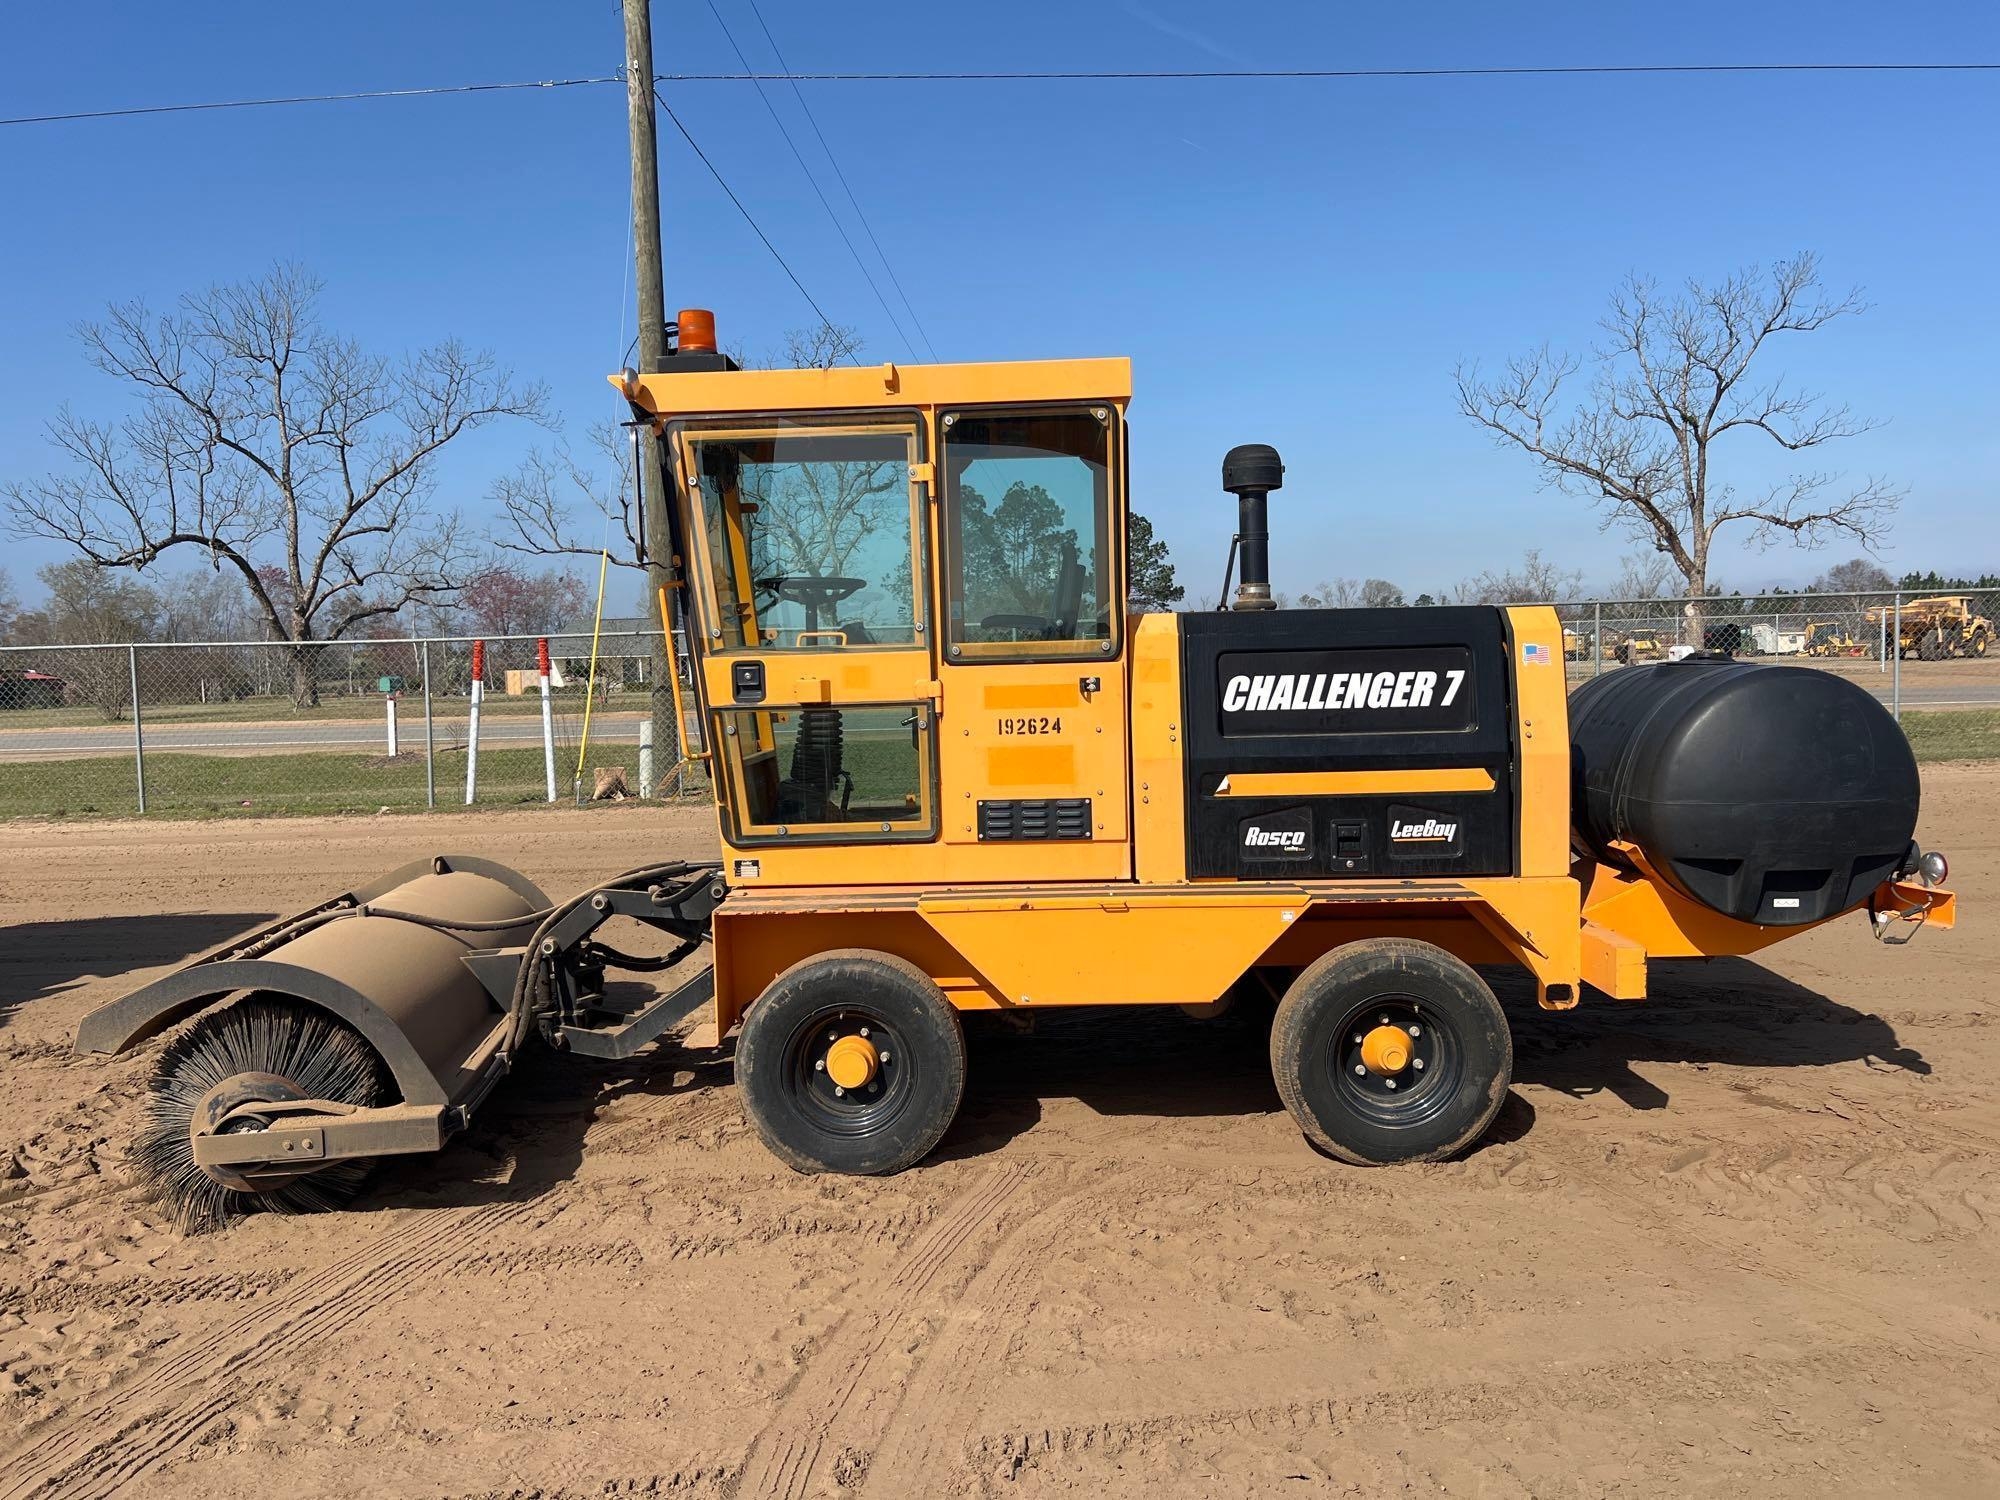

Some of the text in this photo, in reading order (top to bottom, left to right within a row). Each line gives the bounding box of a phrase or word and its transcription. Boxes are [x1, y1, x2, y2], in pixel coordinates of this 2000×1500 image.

[1222, 669, 1465, 712] CHALLENGER 7
[998, 717, 1062, 735] 192624
[1245, 827, 1305, 846] Rosco
[1391, 819, 1457, 842] LeeBoy
